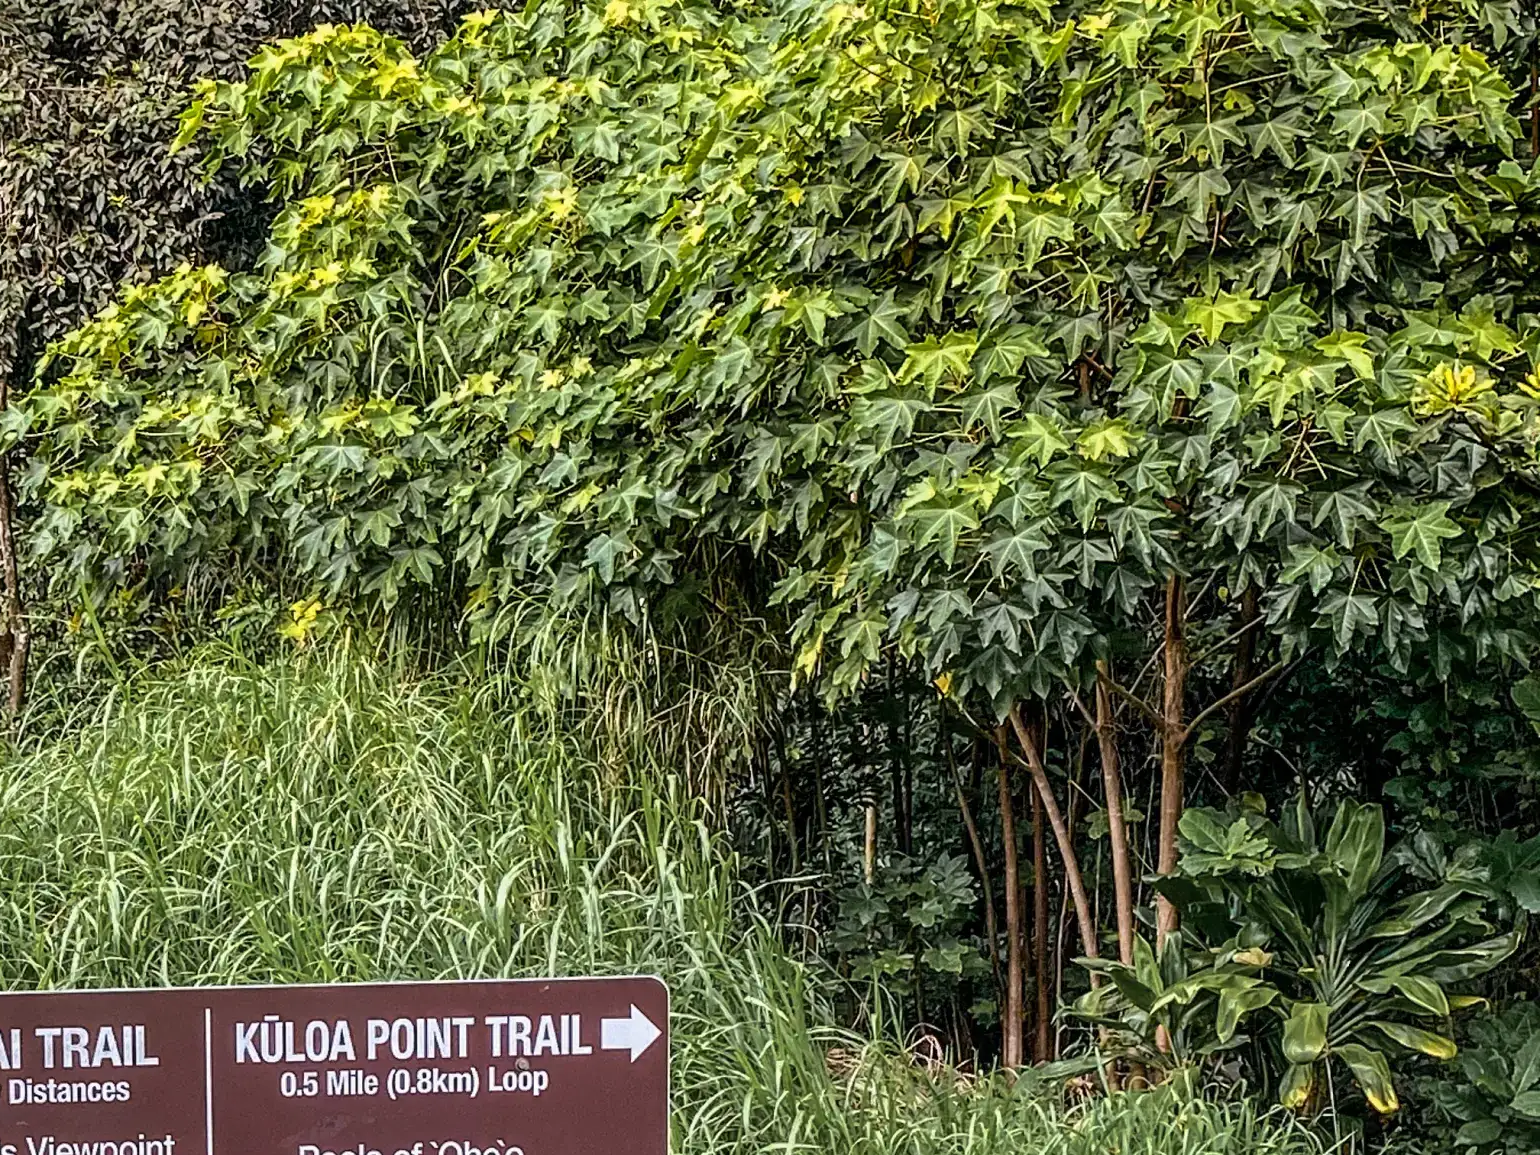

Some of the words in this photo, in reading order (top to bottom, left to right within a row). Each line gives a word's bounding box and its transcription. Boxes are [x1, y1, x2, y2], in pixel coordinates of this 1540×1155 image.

[35, 1025, 159, 1068] TRAIL
[234, 1015, 355, 1064] KŪLOA
[367, 1017, 474, 1060] POINT
[485, 1014, 592, 1057] TRAIL
[9, 1078, 130, 1105] Distances
[280, 1071, 318, 1097] 0.5
[327, 1069, 379, 1096] Mile
[387, 1067, 479, 1099] (0.8km)
[488, 1067, 548, 1095] Loop
